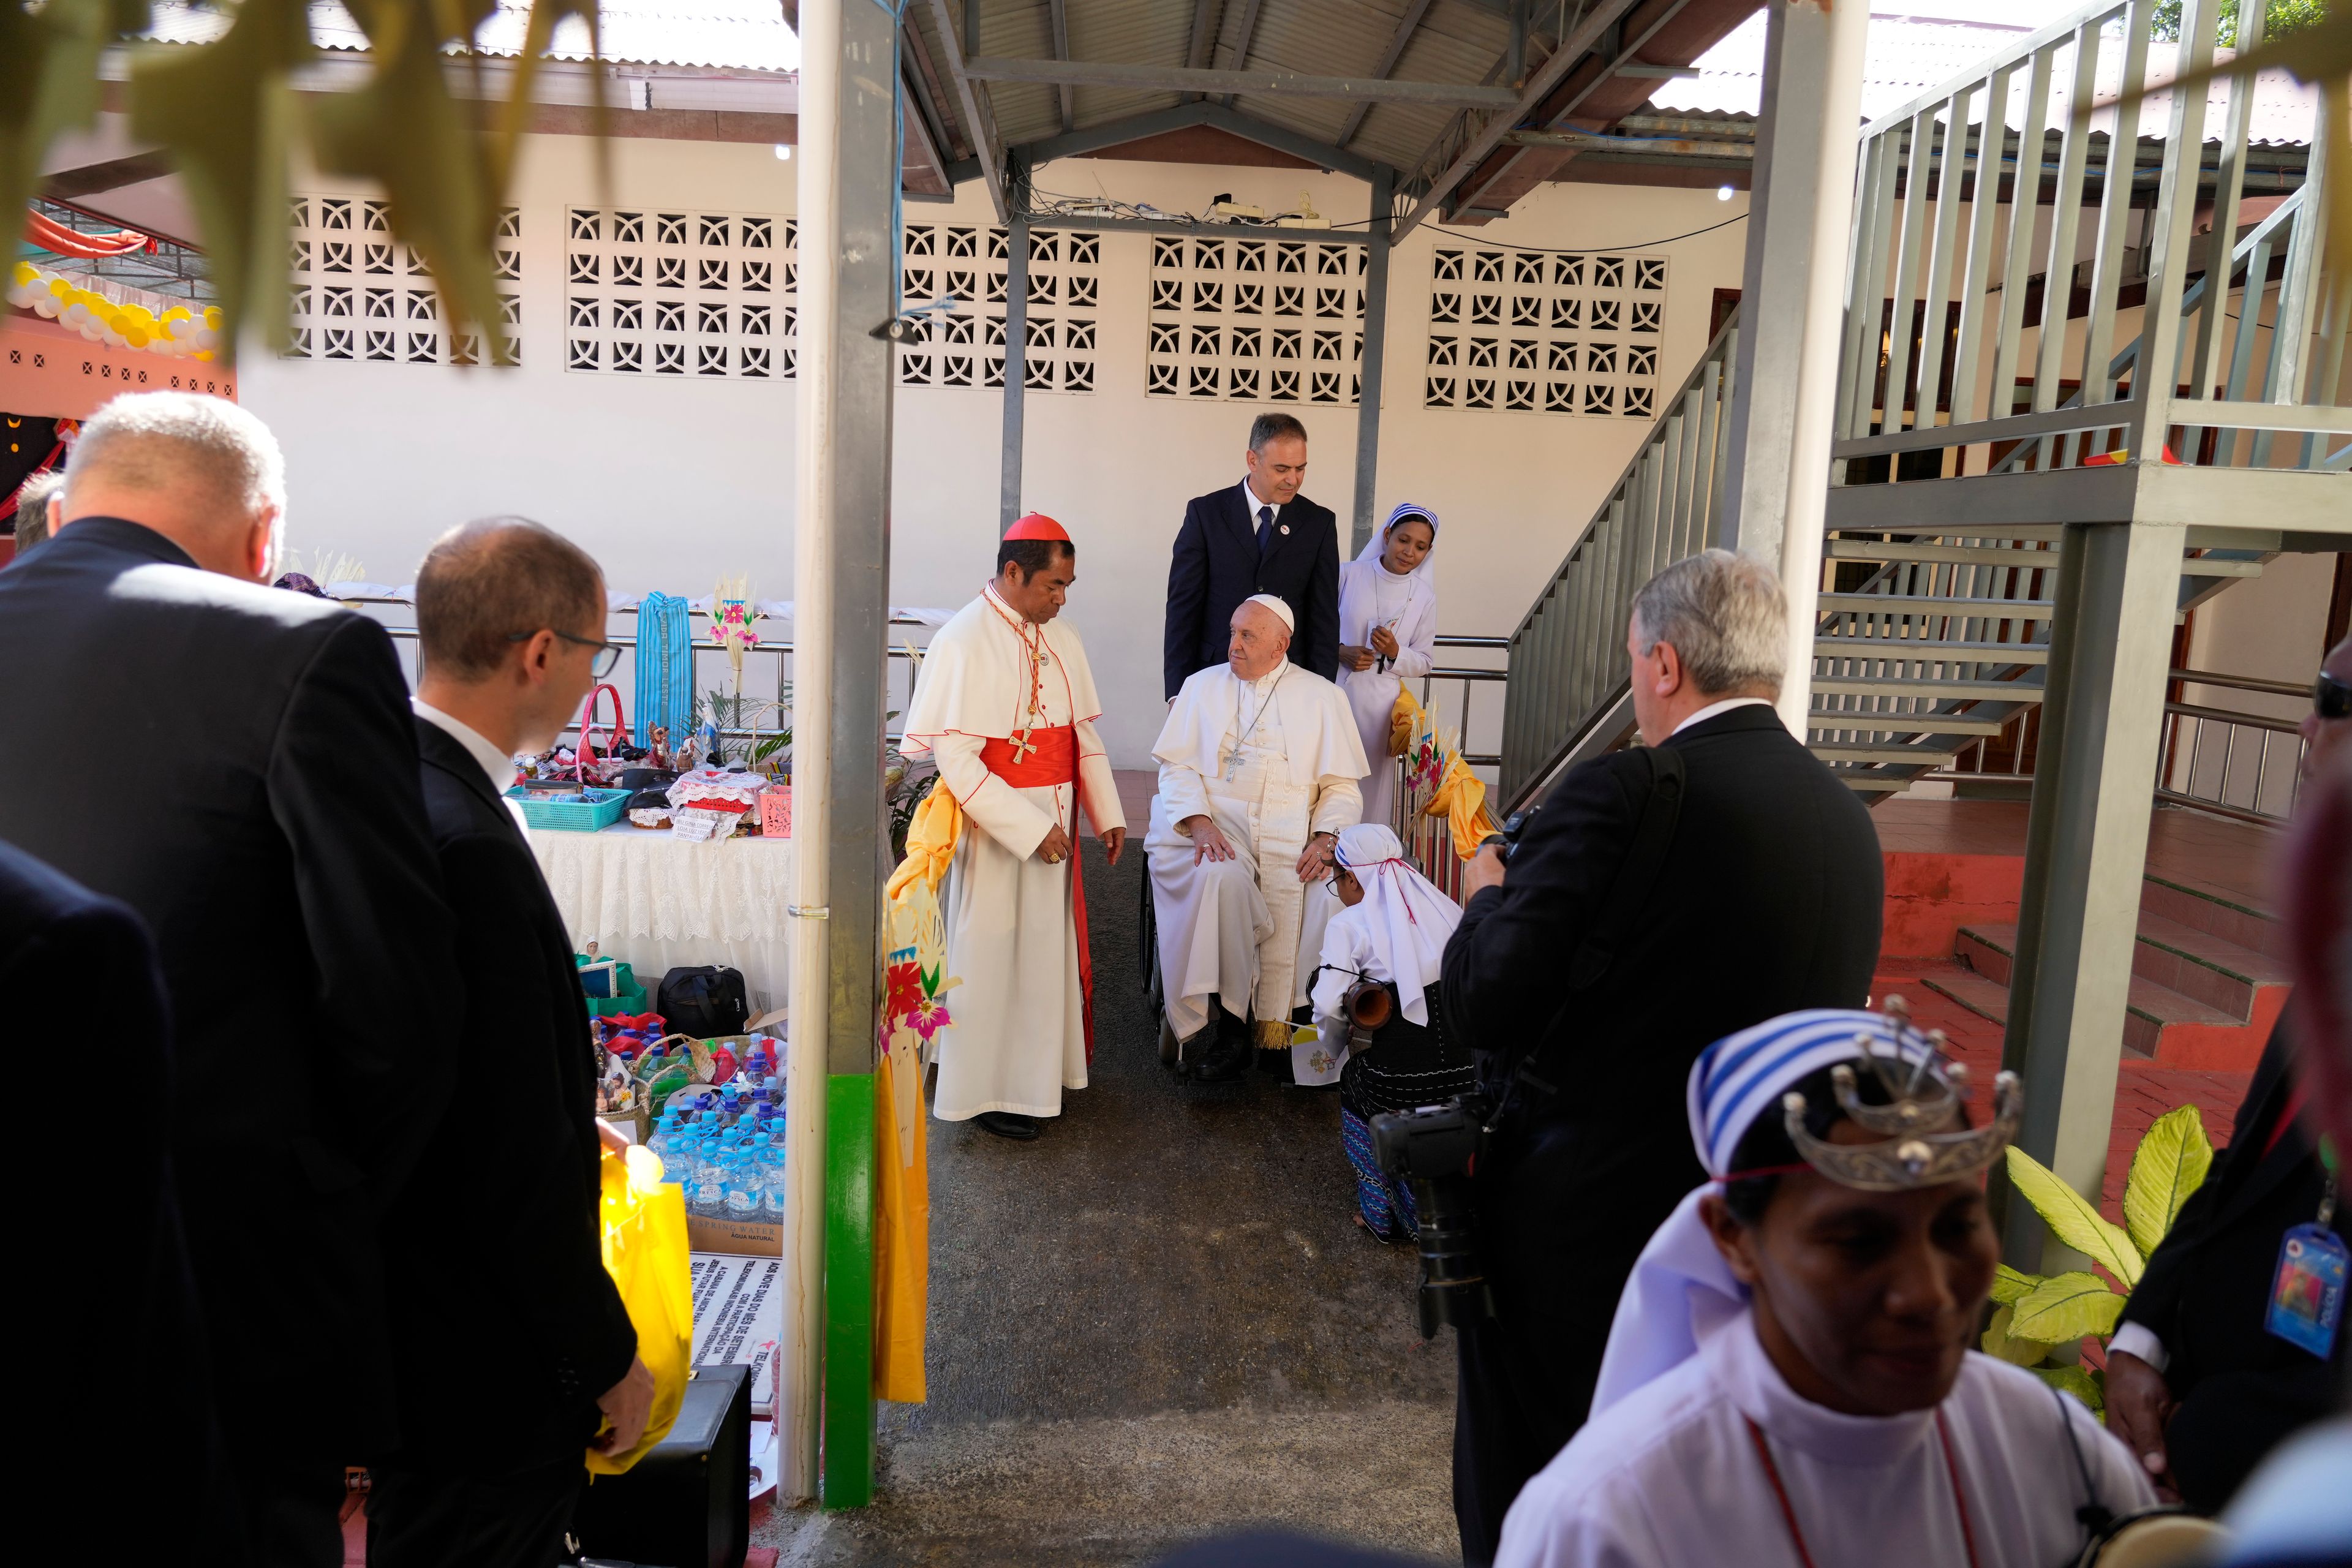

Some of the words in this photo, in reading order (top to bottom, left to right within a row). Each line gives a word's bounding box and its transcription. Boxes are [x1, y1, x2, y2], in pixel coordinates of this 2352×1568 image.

[698, 1220, 736, 1232] SPRING
[740, 1225, 775, 1235] WATER
[706, 1259, 720, 1273] JESUS
[766, 1262, 780, 1273] AOS
[696, 1273, 712, 1289] FUTAR
[709, 1270, 726, 1289] CABANA
[728, 1260, 756, 1300] TELEKOMUNIKASI
[758, 1273, 775, 1289] NOVE
[696, 1297, 711, 1311] AMOR
[752, 1289, 767, 1303] DIAS
[714, 1300, 736, 1326] INDONESIA
[747, 1303, 761, 1312] DO
[741, 1312, 756, 1325] MÊS
[717, 1309, 743, 1346] PARTICIPAÇÃO
[736, 1325, 749, 1335] DE
[692, 1326, 722, 1366] INTERNATIONAL
[720, 1335, 745, 1365] SETEMBR
[751, 1352, 769, 1389] TELKOM
